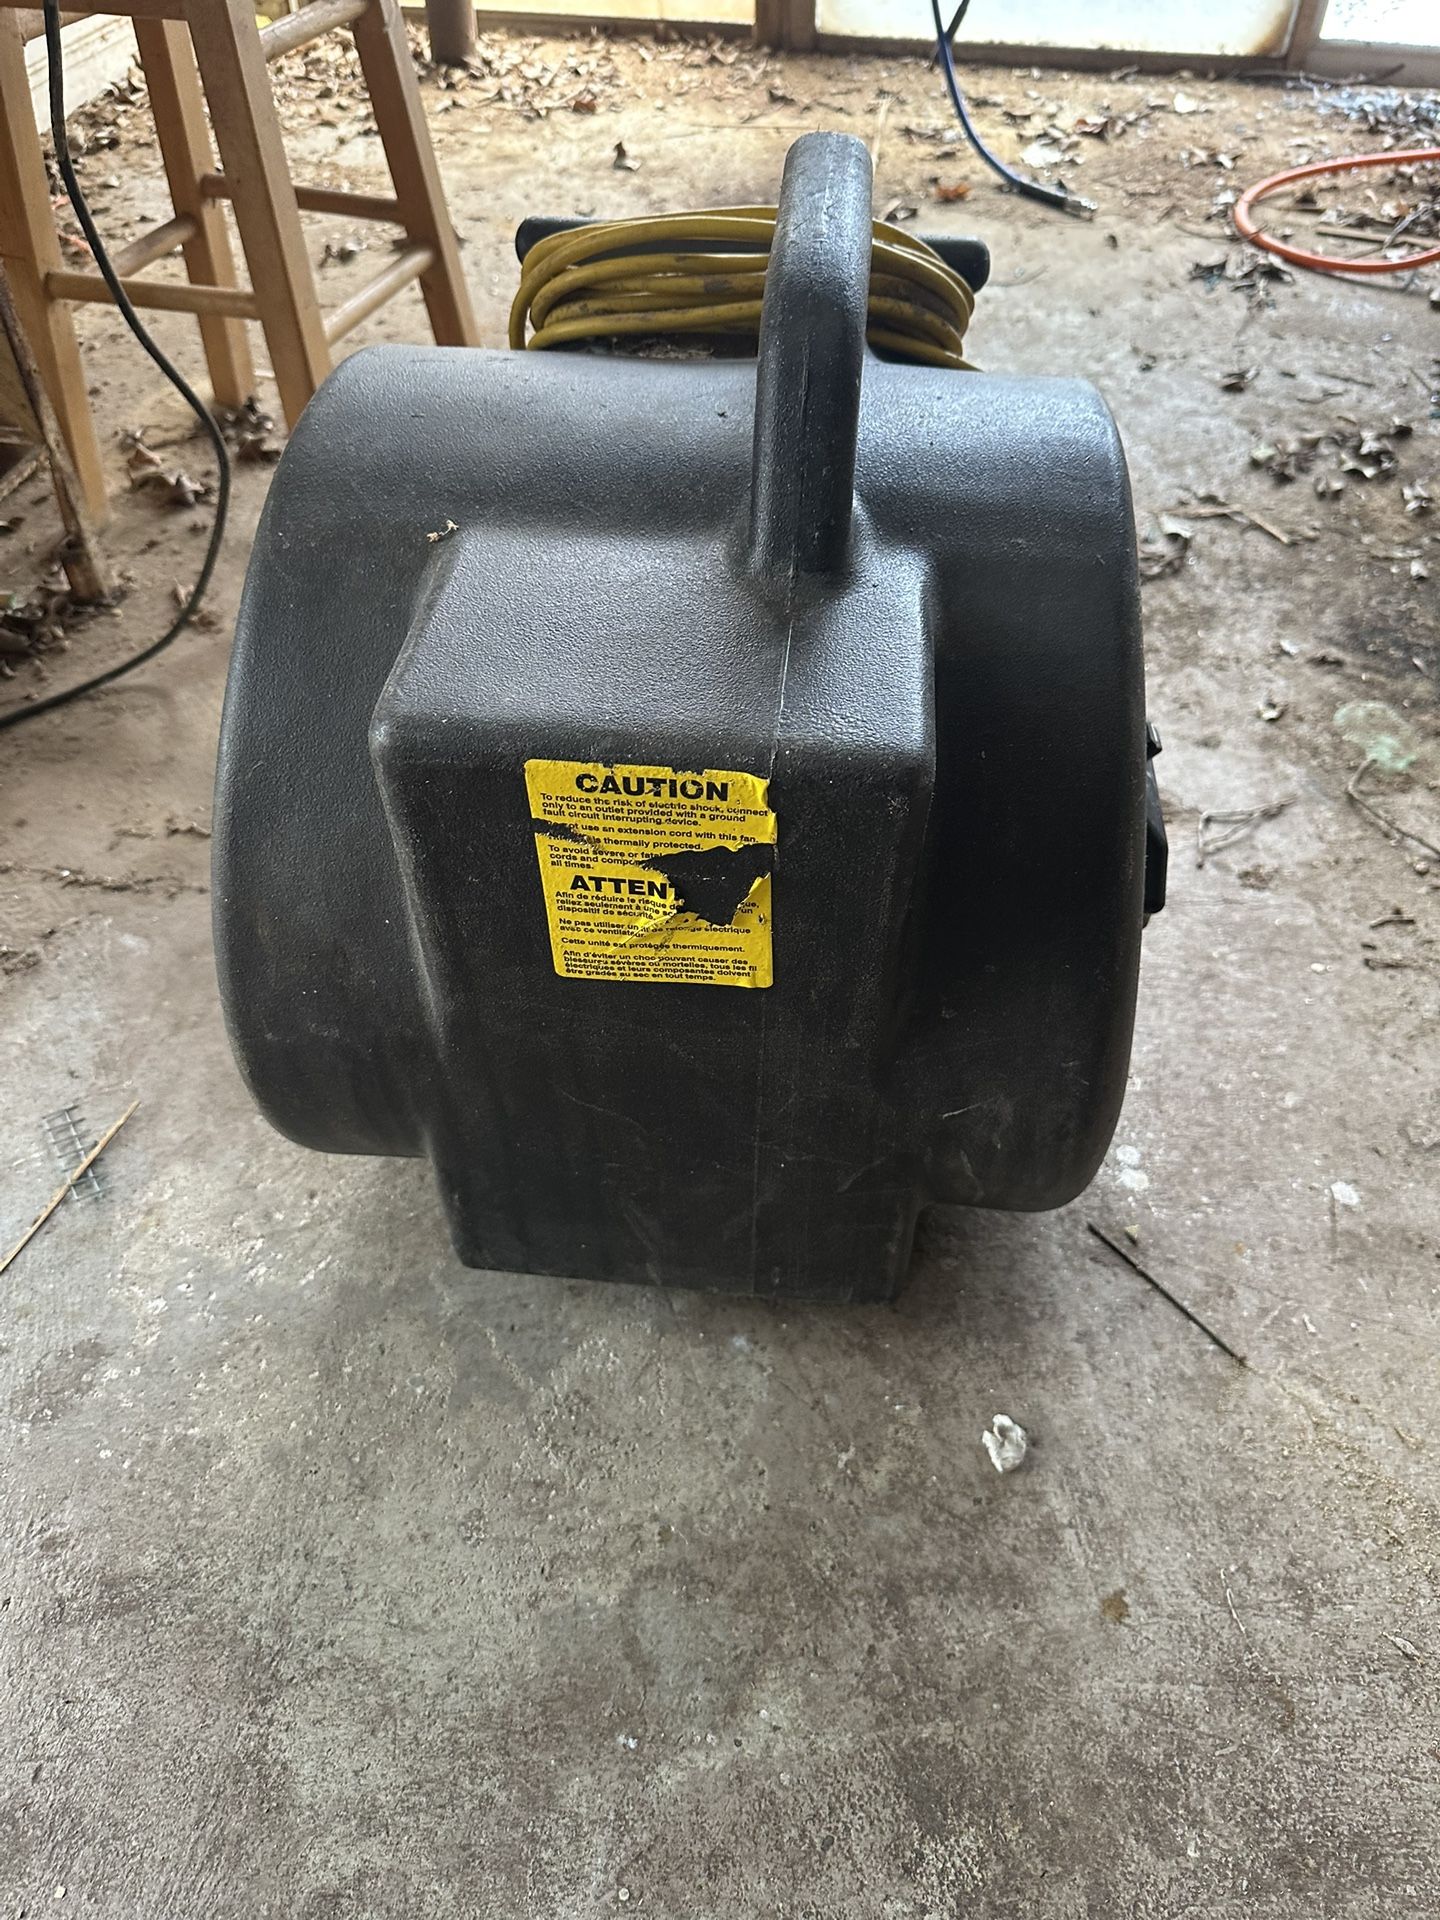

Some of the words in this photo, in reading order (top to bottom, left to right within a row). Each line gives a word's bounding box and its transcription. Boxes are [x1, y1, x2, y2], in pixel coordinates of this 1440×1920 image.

[576, 773, 728, 801] CAUTION
[540, 793, 552, 801] To
[556, 795, 590, 803] reduce
[594, 797, 610, 805] the
[613, 798, 632, 806] risk
[635, 800, 646, 808] of
[542, 802, 563, 810] only
[595, 805, 624, 814] outlet
[627, 808, 672, 816] provided
[676, 810, 697, 818] with
[709, 814, 745, 822] ground
[543, 808, 565, 816] fault
[569, 811, 600, 820] circuit
[603, 813, 662, 825] interrupting
[582, 823, 599, 831] use
[617, 826, 666, 835] extension
[669, 829, 692, 837] cord
[695, 831, 716, 839] with
[719, 833, 737, 841] this
[563, 846, 589, 854] avoid
[592, 849, 625, 857] severe
[604, 837, 650, 848] thermally
[653, 841, 703, 850] protected.
[550, 853, 577, 861] cords
[570, 875, 675, 899] ATTEN
